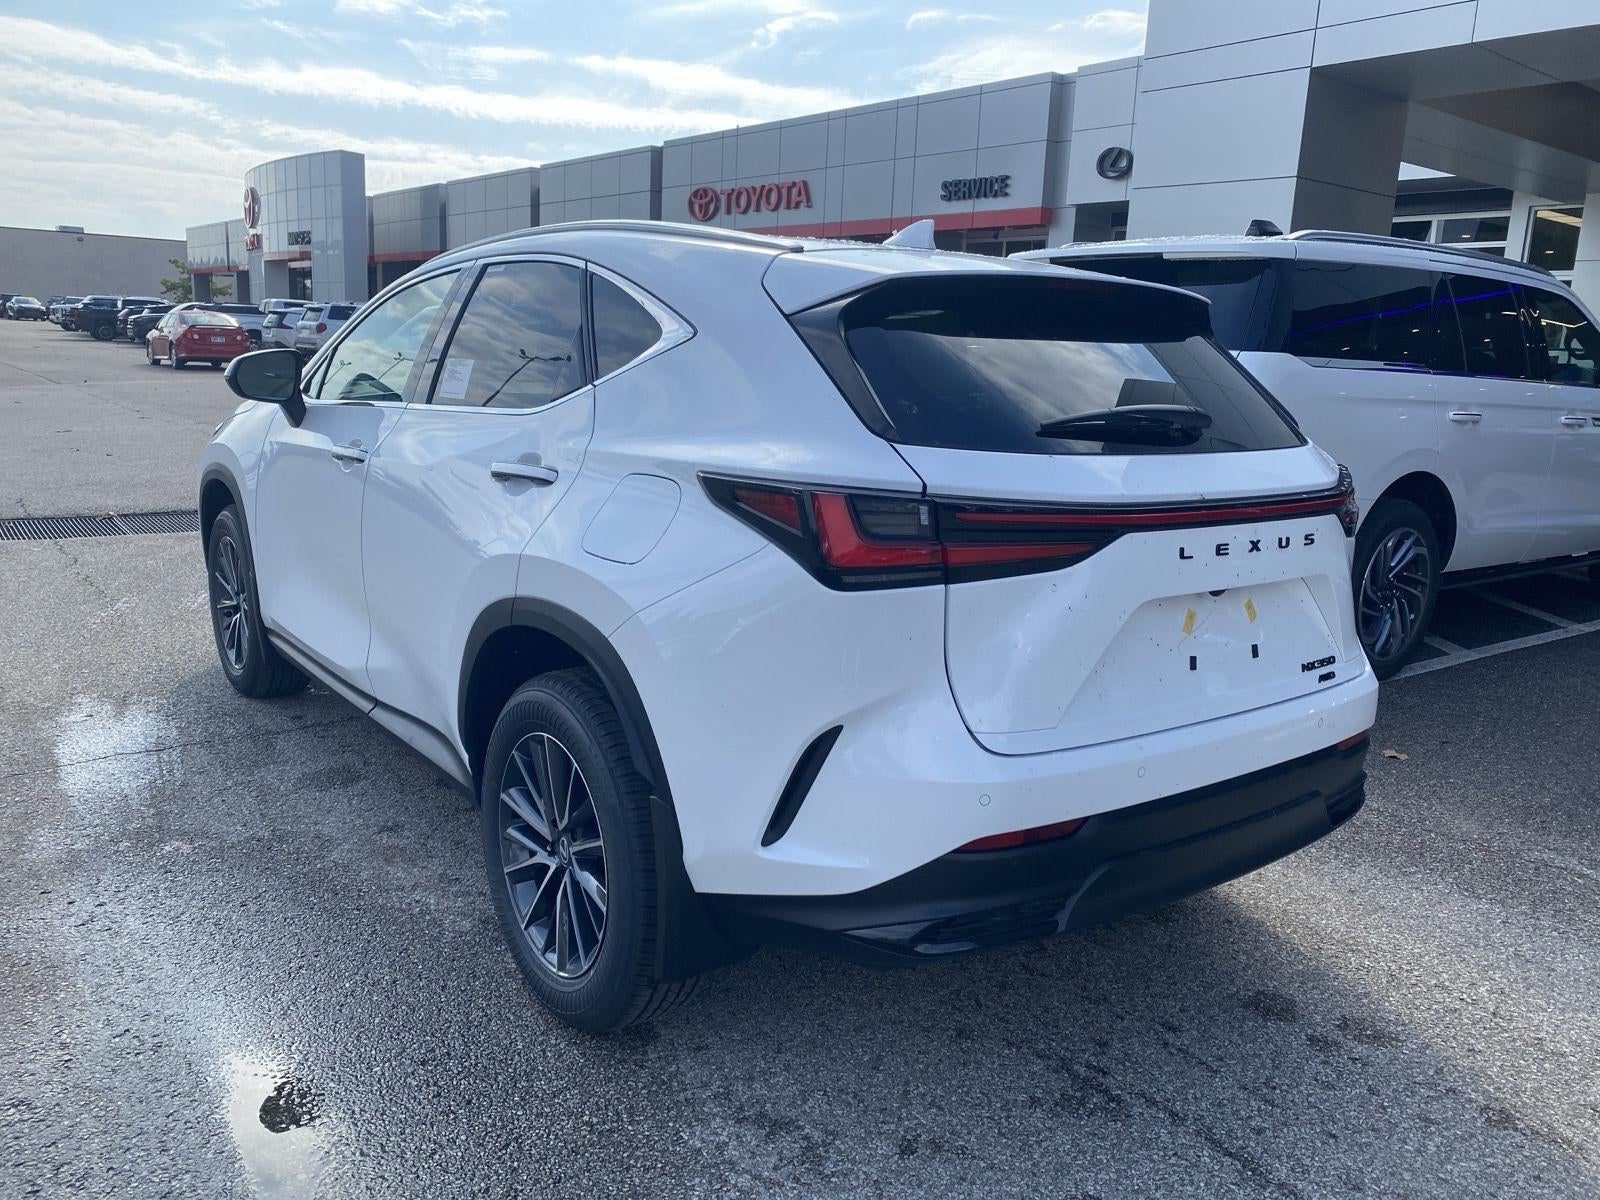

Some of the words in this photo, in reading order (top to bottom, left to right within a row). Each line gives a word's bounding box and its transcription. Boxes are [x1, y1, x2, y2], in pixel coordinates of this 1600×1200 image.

[720, 180, 812, 215] TOYOTA
[940, 175, 1010, 202] SERVICE
[1179, 533, 1315, 560] LEXUS
[1301, 655, 1336, 673] NX350
